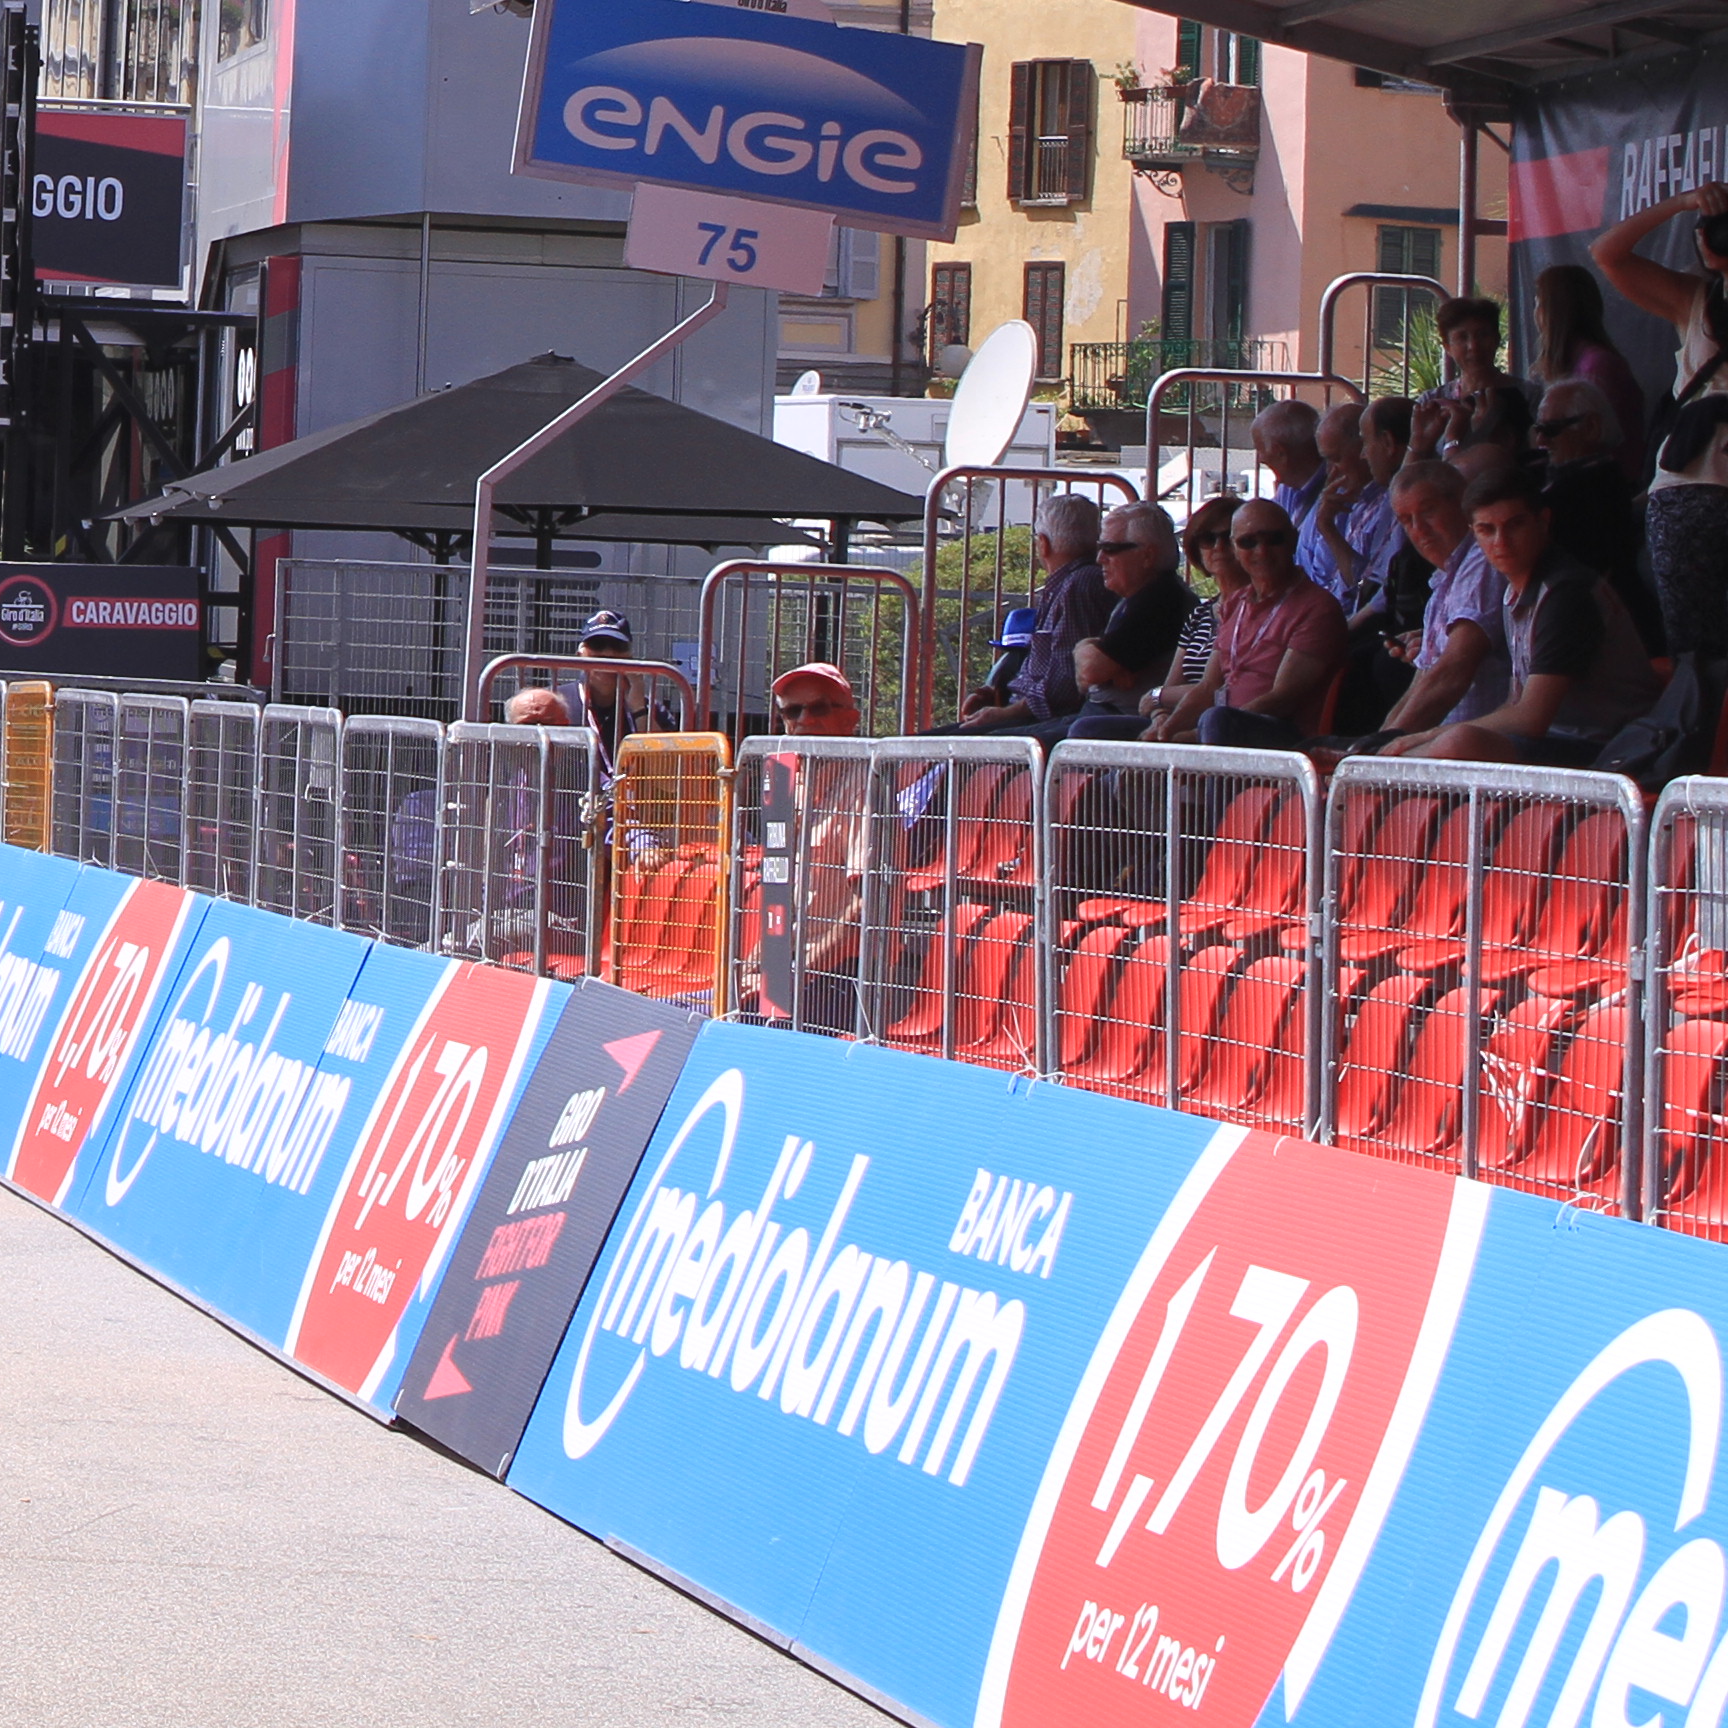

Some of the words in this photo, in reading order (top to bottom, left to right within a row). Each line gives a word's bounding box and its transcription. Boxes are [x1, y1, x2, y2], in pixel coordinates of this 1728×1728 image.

[695, 221, 759, 273] 75
[1, 608, 18, 622] Giro
[19, 608, 45, 622] d'Italia
[72, 601, 197, 626] CARAVAGGIO
[46, 909, 85, 959] BANCA
[58, 935, 150, 1089] 1,70%
[324, 997, 384, 1063] BANCA
[136, 979, 353, 1195] mediolanum
[549, 1086, 606, 1148] GIRO
[354, 1032, 487, 1230] 1,70%
[506, 1147, 588, 1215] D'ITALIA
[949, 1167, 1073, 1279] BANCA
[330, 1250, 362, 1294] per
[353, 1247, 377, 1293] 12
[363, 1259, 402, 1304] mesi
[601, 1134, 1025, 1486] mediolanum
[1091, 1245, 1360, 1591] 1,70%
[1061, 1600, 1124, 1670] per
[1115, 1602, 1158, 1680] 12
[1142, 1634, 1226, 1710] mesi
